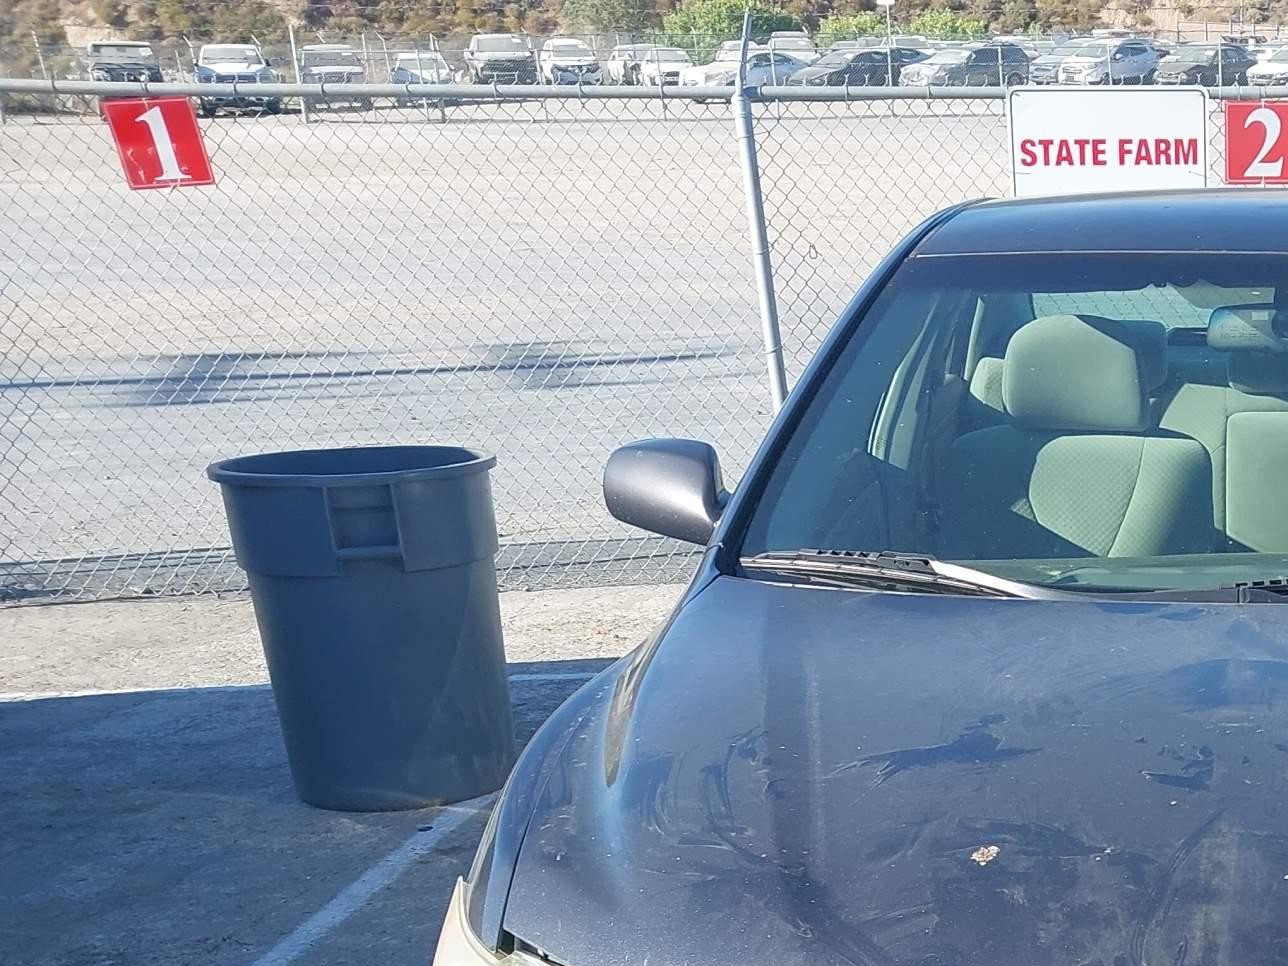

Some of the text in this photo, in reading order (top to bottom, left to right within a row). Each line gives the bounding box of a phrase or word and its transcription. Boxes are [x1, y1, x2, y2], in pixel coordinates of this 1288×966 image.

[134, 105, 192, 180] 1
[1020, 138, 1198, 167] STATE FARM
[1243, 107, 1284, 177] 2
